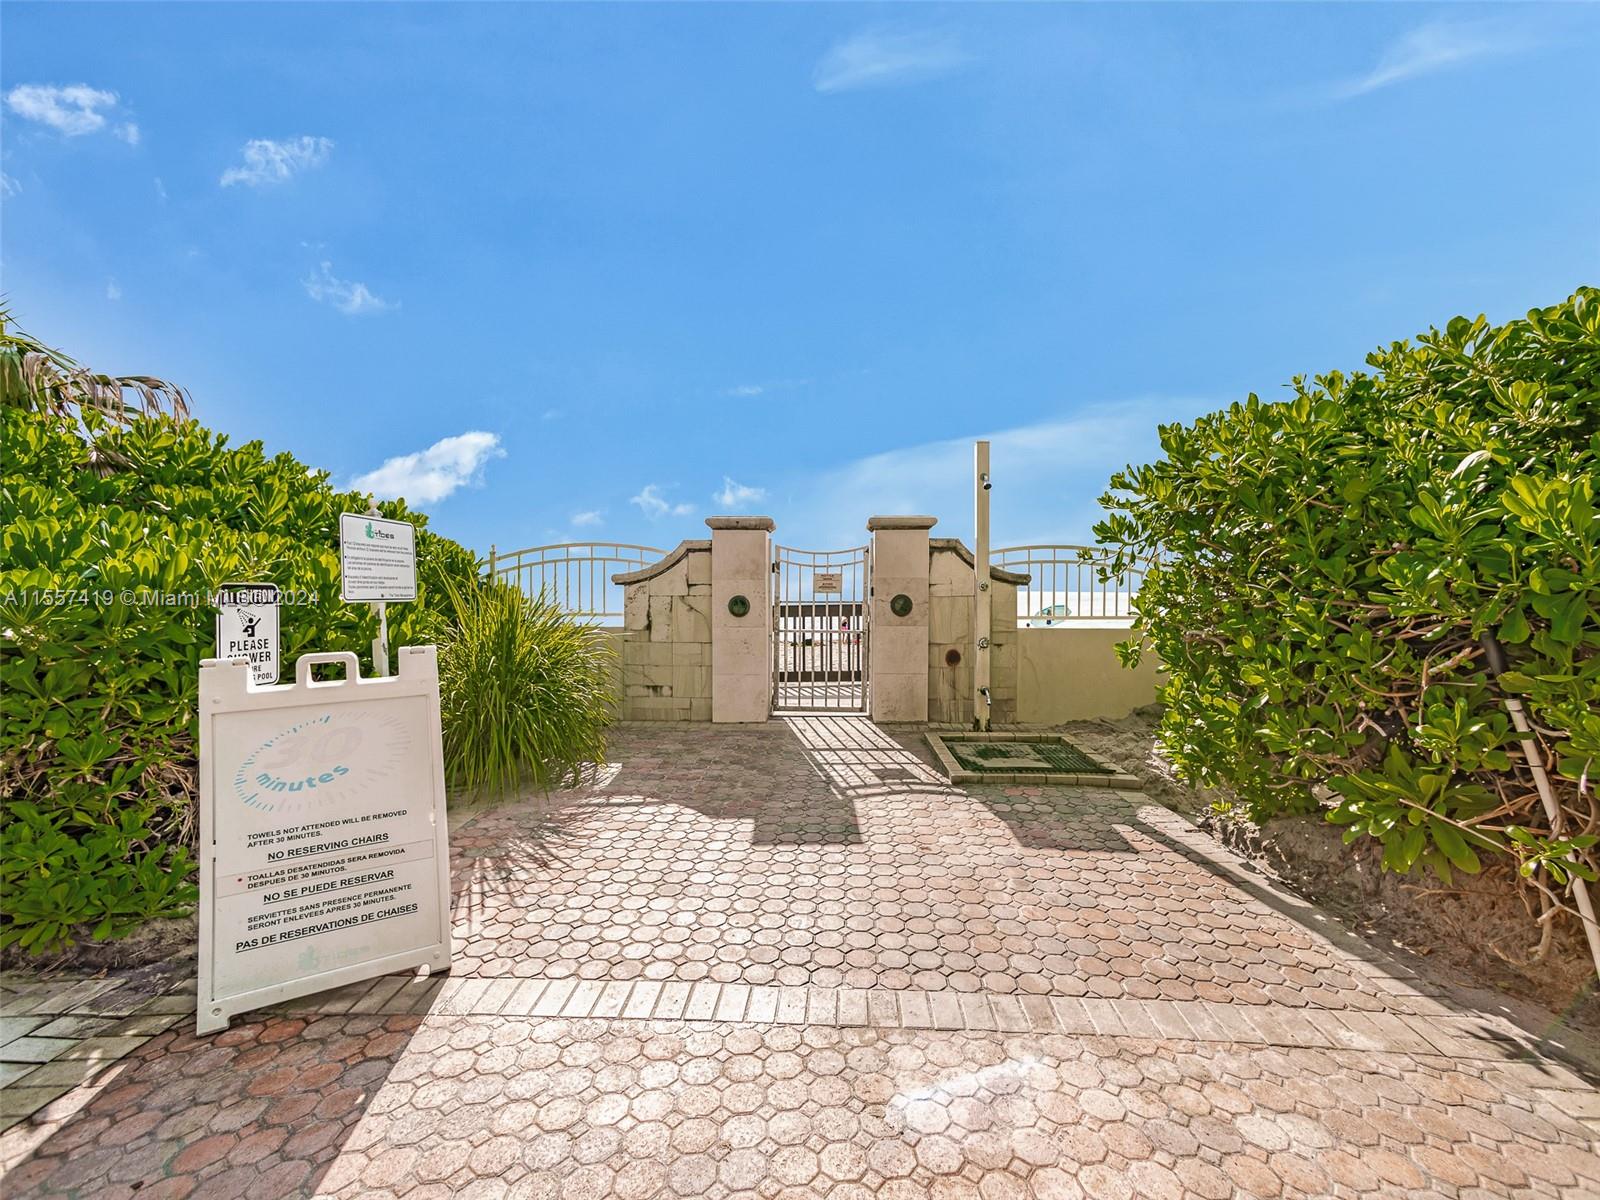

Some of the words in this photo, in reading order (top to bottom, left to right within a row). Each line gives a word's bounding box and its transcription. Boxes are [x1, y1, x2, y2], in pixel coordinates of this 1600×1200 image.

[230, 639, 269, 651] PLEASE
[256, 765, 349, 792] minutes
[248, 829, 281, 840] TOWELS
[283, 826, 299, 834] NOT
[301, 820, 340, 831] ATTENDED
[342, 817, 360, 825] WILL
[361, 814, 371, 822] BE
[373, 810, 407, 821] REMOVED
[247, 838, 274, 848] AFTER
[276, 836, 285, 844] 30
[287, 831, 322, 842] MINUTES.
[268, 850, 284, 860] NO
[287, 840, 348, 857] RESERVING
[352, 833, 389, 845] CHAIRS
[248, 870, 286, 881] TOALLAS
[287, 858, 345, 874] DESATENDIDAS
[347, 854, 367, 863] SERA
[369, 848, 405, 859] REMOVIDA
[248, 878, 286, 889] DESPUES
[311, 866, 347, 878] MINUTOS.
[264, 892, 280, 902] NO
[284, 889, 298, 898] SE
[301, 882, 337, 895] PUEDE
[340, 870, 394, 887] RESERVAR
[248, 908, 297, 923] SERVIETTES
[299, 903, 320, 912] SANS
[322, 894, 362, 908] PRESENCE
[364, 884, 412, 899] PERMANENTE
[236, 939, 258, 950] PAS
[262, 935, 277, 945] DE
[280, 916, 358, 940] RESERVATIONS
[361, 913, 374, 922] DE
[377, 903, 418, 918] CHAISES
[248, 921, 282, 931] SERONT
[283, 909, 324, 923] ENLEVEES
[326, 904, 352, 914] APRES
